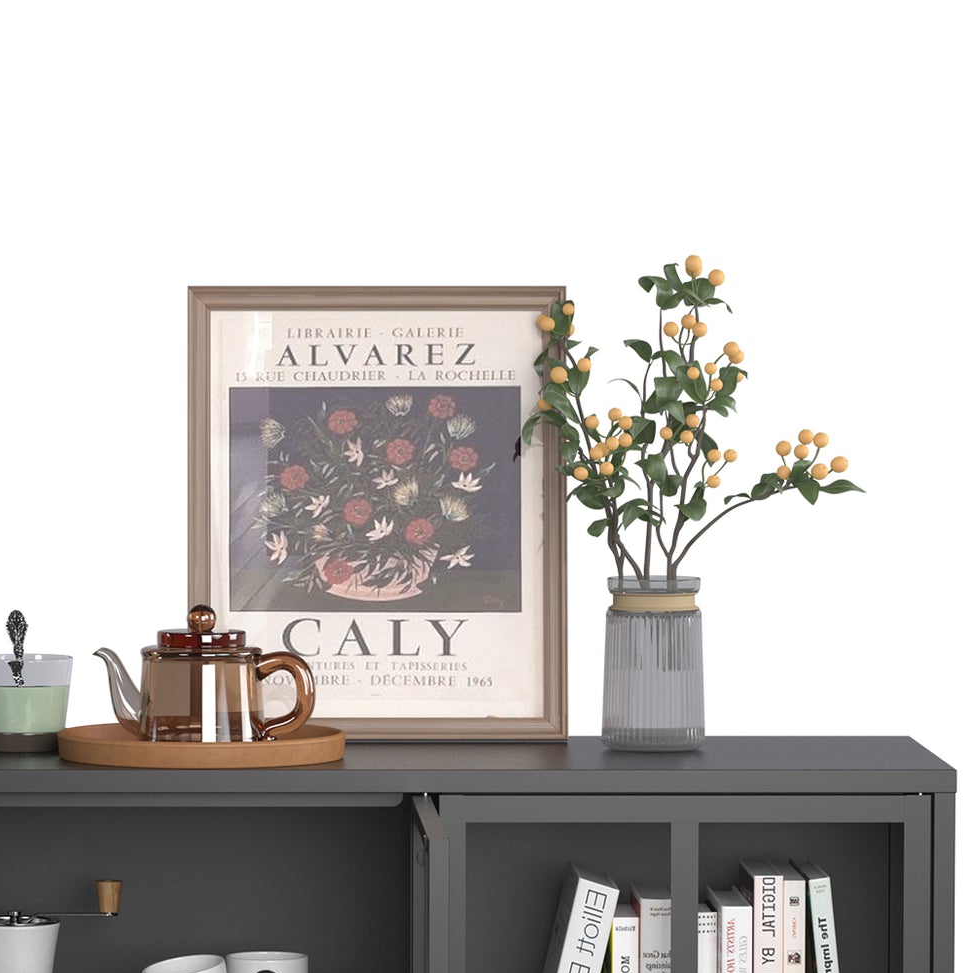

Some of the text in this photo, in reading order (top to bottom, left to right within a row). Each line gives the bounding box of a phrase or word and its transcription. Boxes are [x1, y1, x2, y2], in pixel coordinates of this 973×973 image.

[287, 327, 372, 339] LIBRAIRIE
[391, 327, 465, 338] GALERIE
[276, 343, 476, 367] ALVAREZ
[255, 371, 286, 382] RUE
[293, 370, 386, 382] CHAUDRIER
[408, 370, 427, 381] LA
[435, 370, 516, 381] ROCHELLE
[282, 618, 469, 657] CALY
[308, 661, 468, 672] NTURES ET TAPISSERIES
[264, 674, 349, 688] NOVBRE
[370, 673, 457, 687] DÉCEMBRE
[467, 676, 493, 687] 1965
